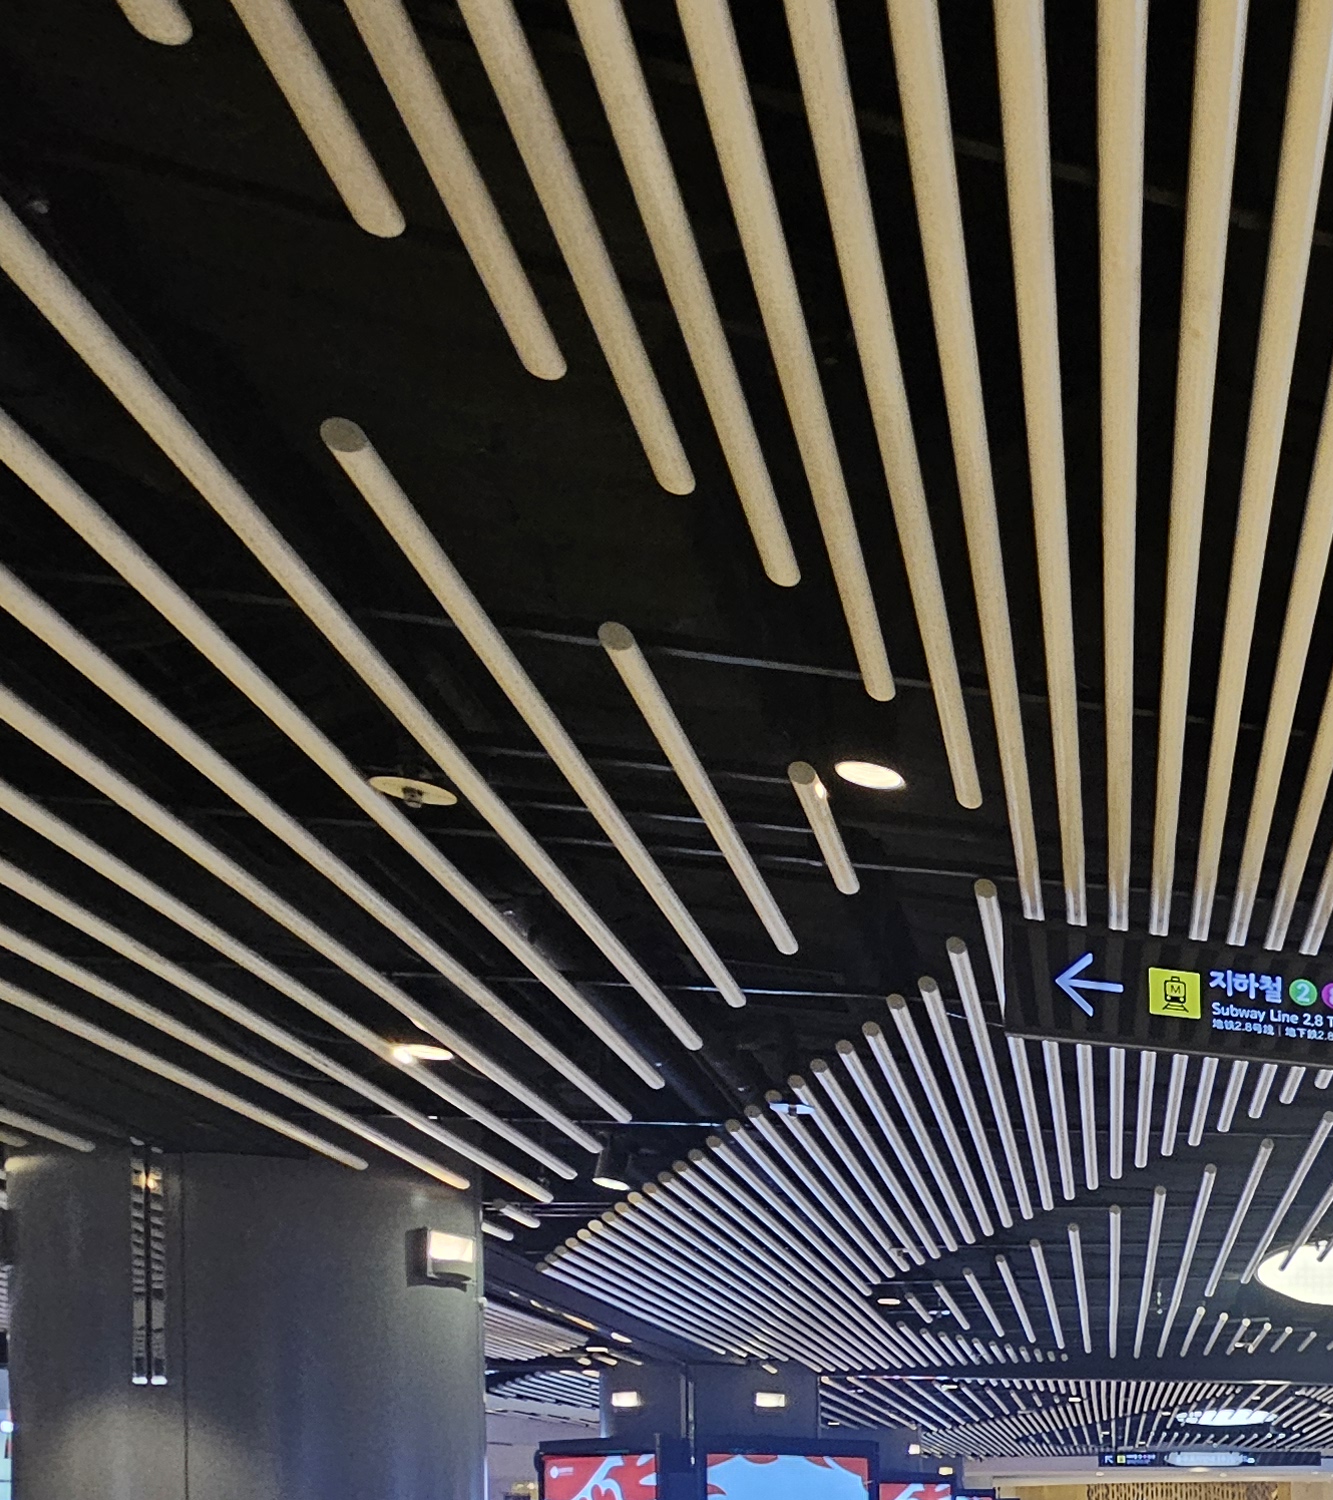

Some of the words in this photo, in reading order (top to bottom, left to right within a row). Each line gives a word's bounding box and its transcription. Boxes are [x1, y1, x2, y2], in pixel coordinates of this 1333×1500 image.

[1208, 969, 1282, 1004] 지하철
[1211, 1002, 1266, 1023] Subway
[1269, 1009, 1299, 1025] Line
